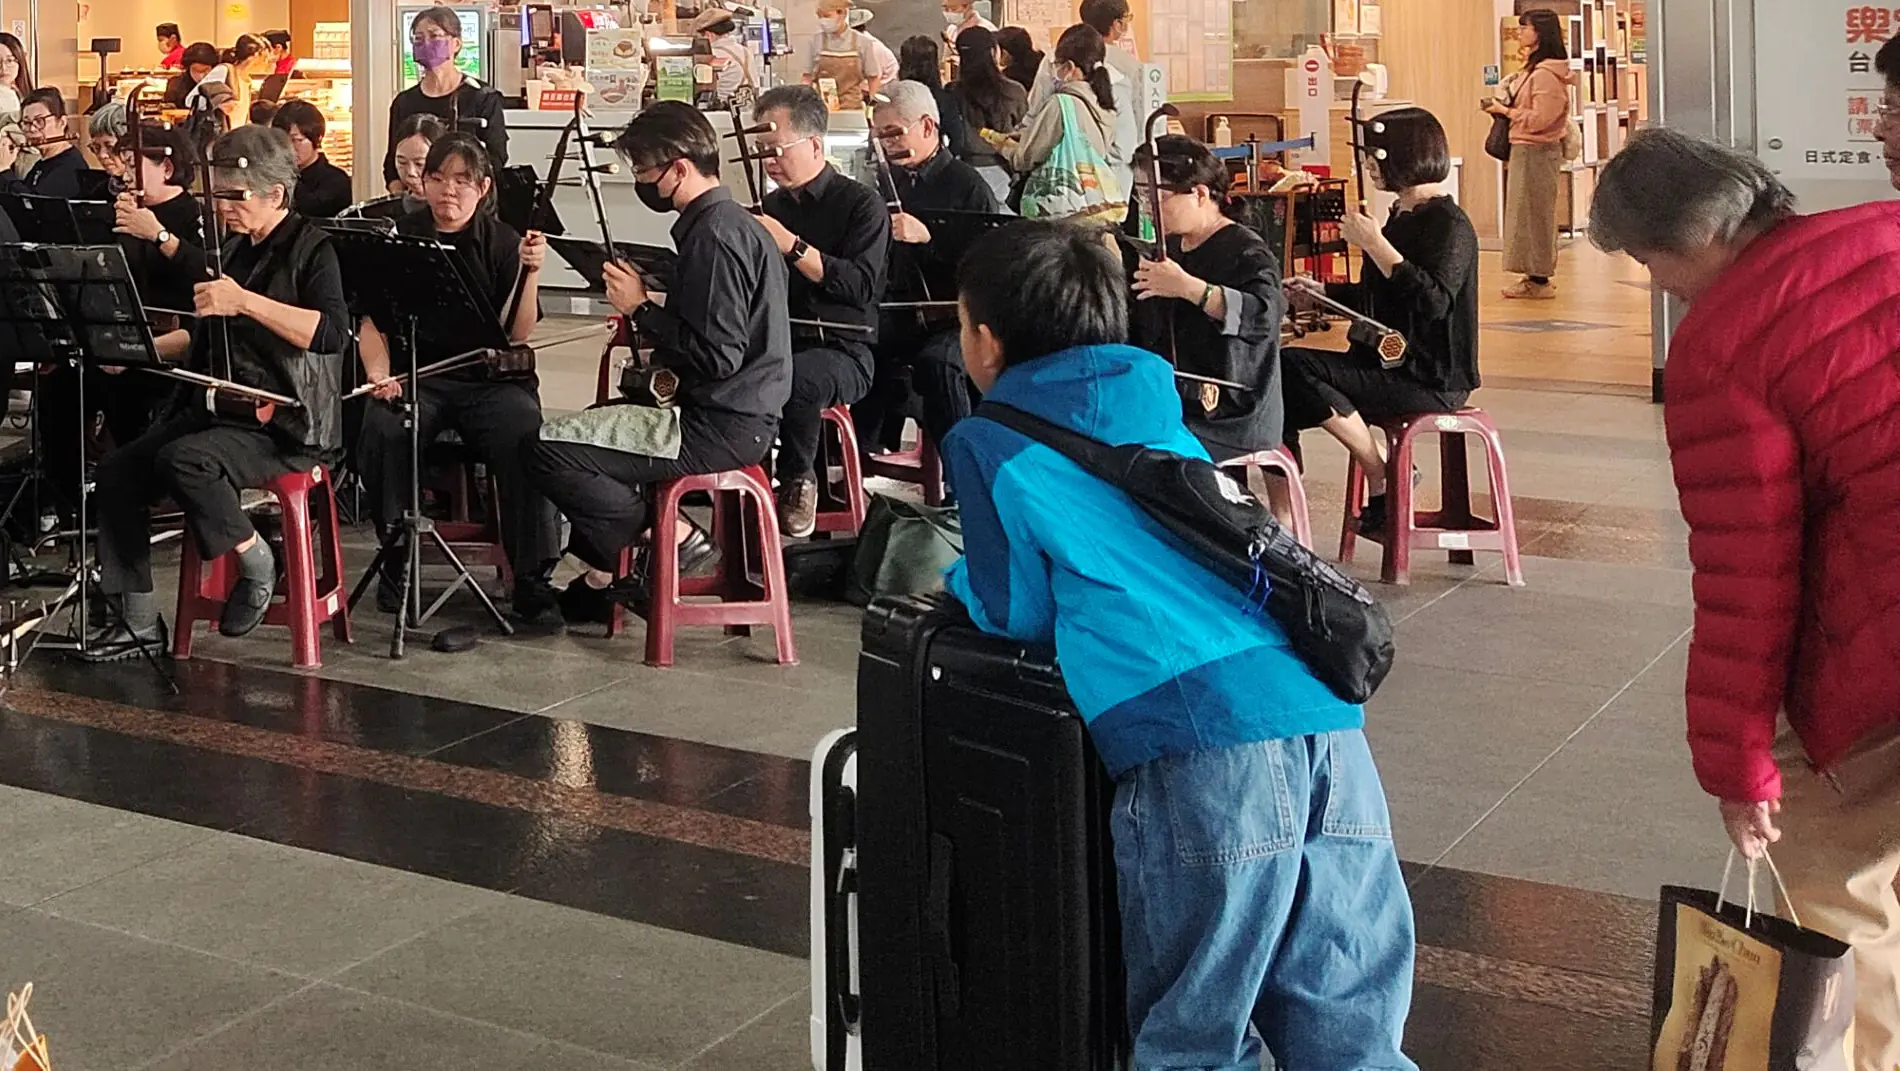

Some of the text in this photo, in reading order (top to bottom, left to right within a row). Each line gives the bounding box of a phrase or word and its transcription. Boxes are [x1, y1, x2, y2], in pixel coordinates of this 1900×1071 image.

[1849, 51, 1871, 73] 台
[1308, 77, 1318, 97] 出口
[1151, 90, 1161, 108] 入口
[1805, 150, 1871, 164] 日式定食
